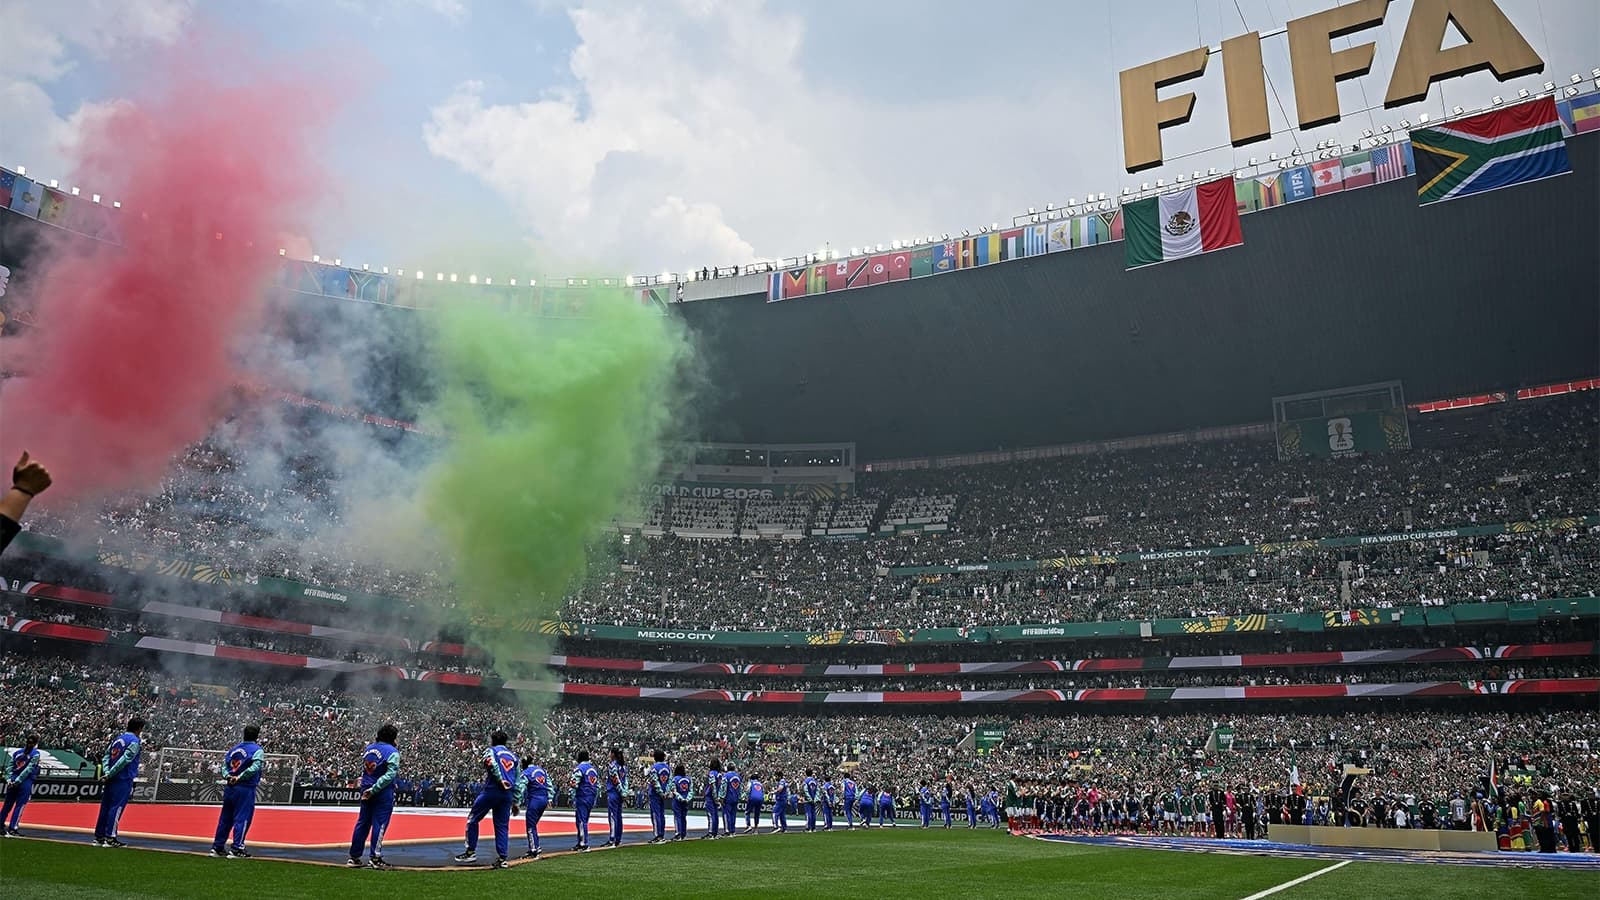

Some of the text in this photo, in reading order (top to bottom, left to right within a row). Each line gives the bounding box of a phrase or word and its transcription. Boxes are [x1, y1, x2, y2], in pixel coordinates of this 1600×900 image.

[1119, 0, 1545, 174] FIFA
[1291, 171, 1305, 198] FIFA
[692, 487, 721, 498] CUP
[723, 488, 773, 499] 2026
[1360, 529, 1458, 544] FIFA WORLD CUP 2026
[1140, 549, 1211, 560] MEXICO CITY
[637, 630, 716, 640] MEXICO CITY
[80, 784, 99, 796] CU
[303, 790, 361, 800] FIFA WORLD
[896, 810, 914, 819] FIFA
[949, 812, 968, 821] CUP
